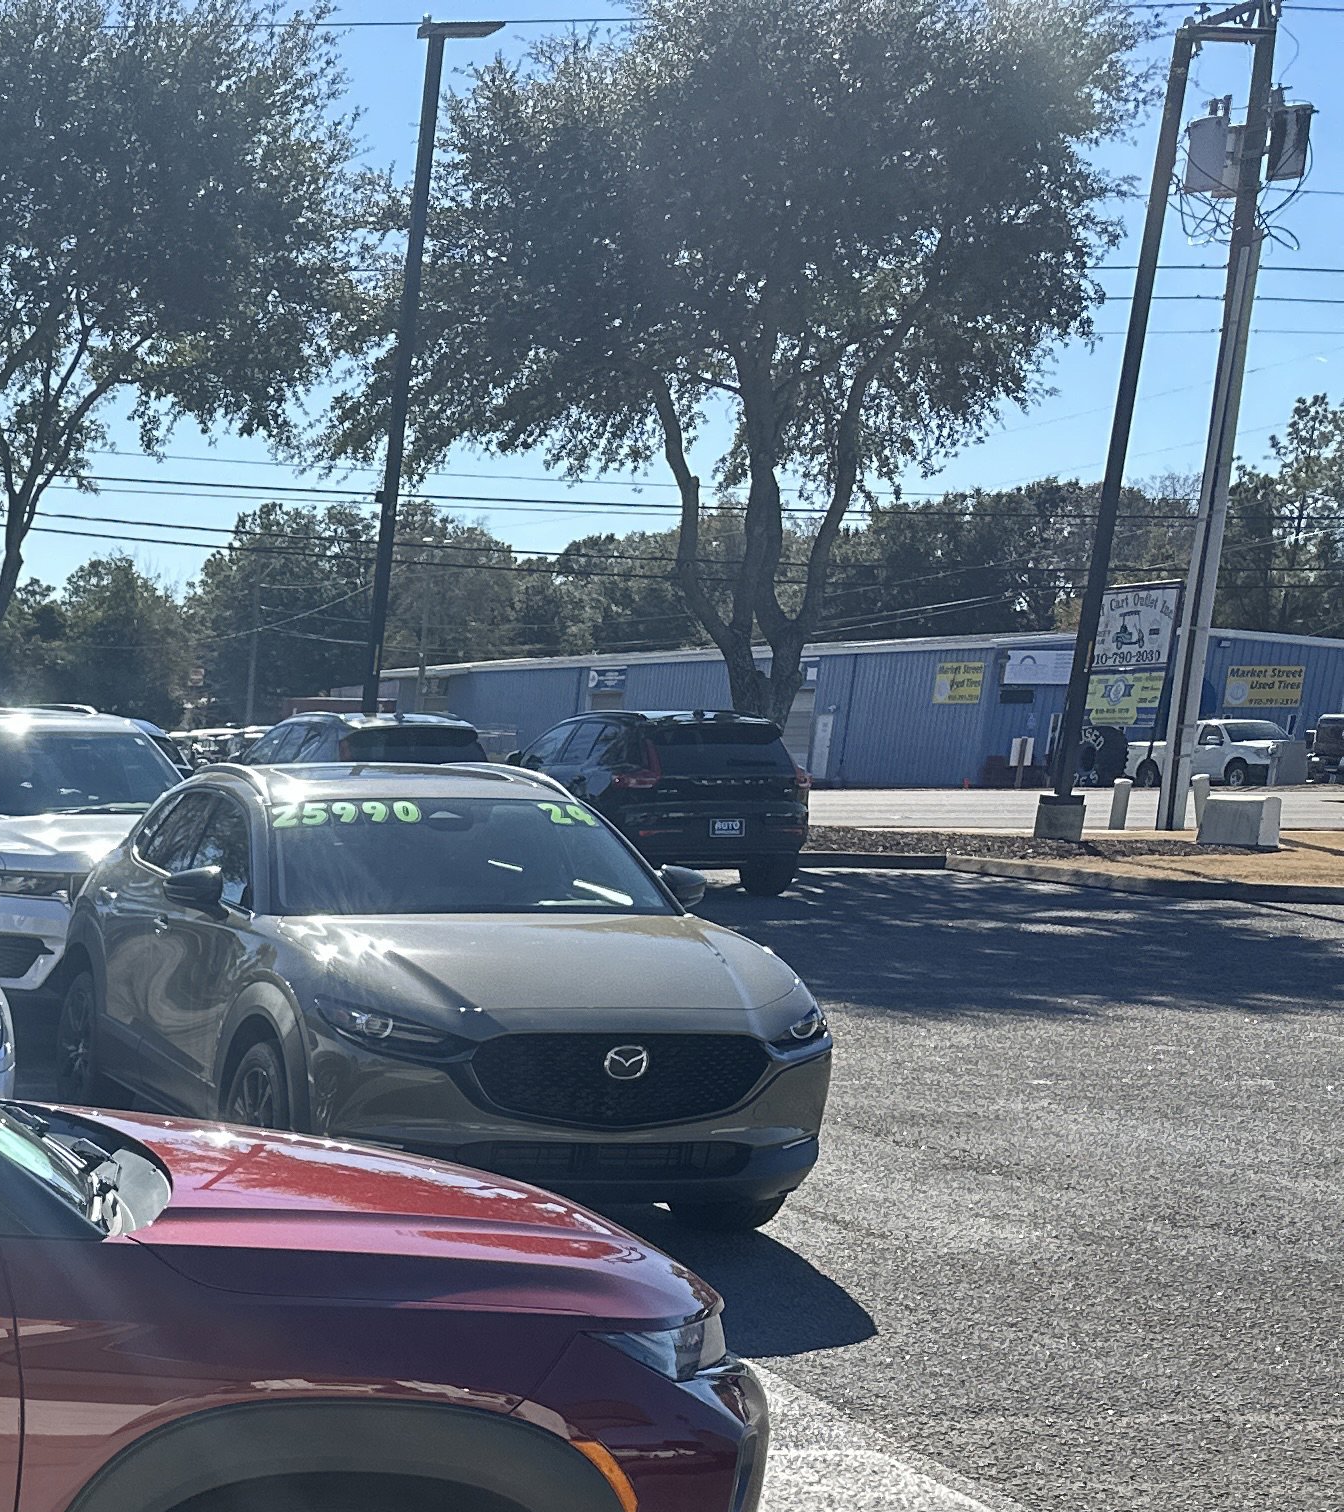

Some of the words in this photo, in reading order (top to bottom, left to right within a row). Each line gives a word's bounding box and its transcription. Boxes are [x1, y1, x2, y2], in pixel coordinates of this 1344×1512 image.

[1092, 650, 1160, 666] 10-790-2030
[1229, 668, 1267, 678] Market
[1271, 668, 1303, 678] Street
[1250, 681, 1274, 690] Used
[1278, 681, 1301, 690] Tires
[271, 801, 422, 828] 25990
[537, 803, 598, 827] 24
[714, 821, 740, 830] AUTO
